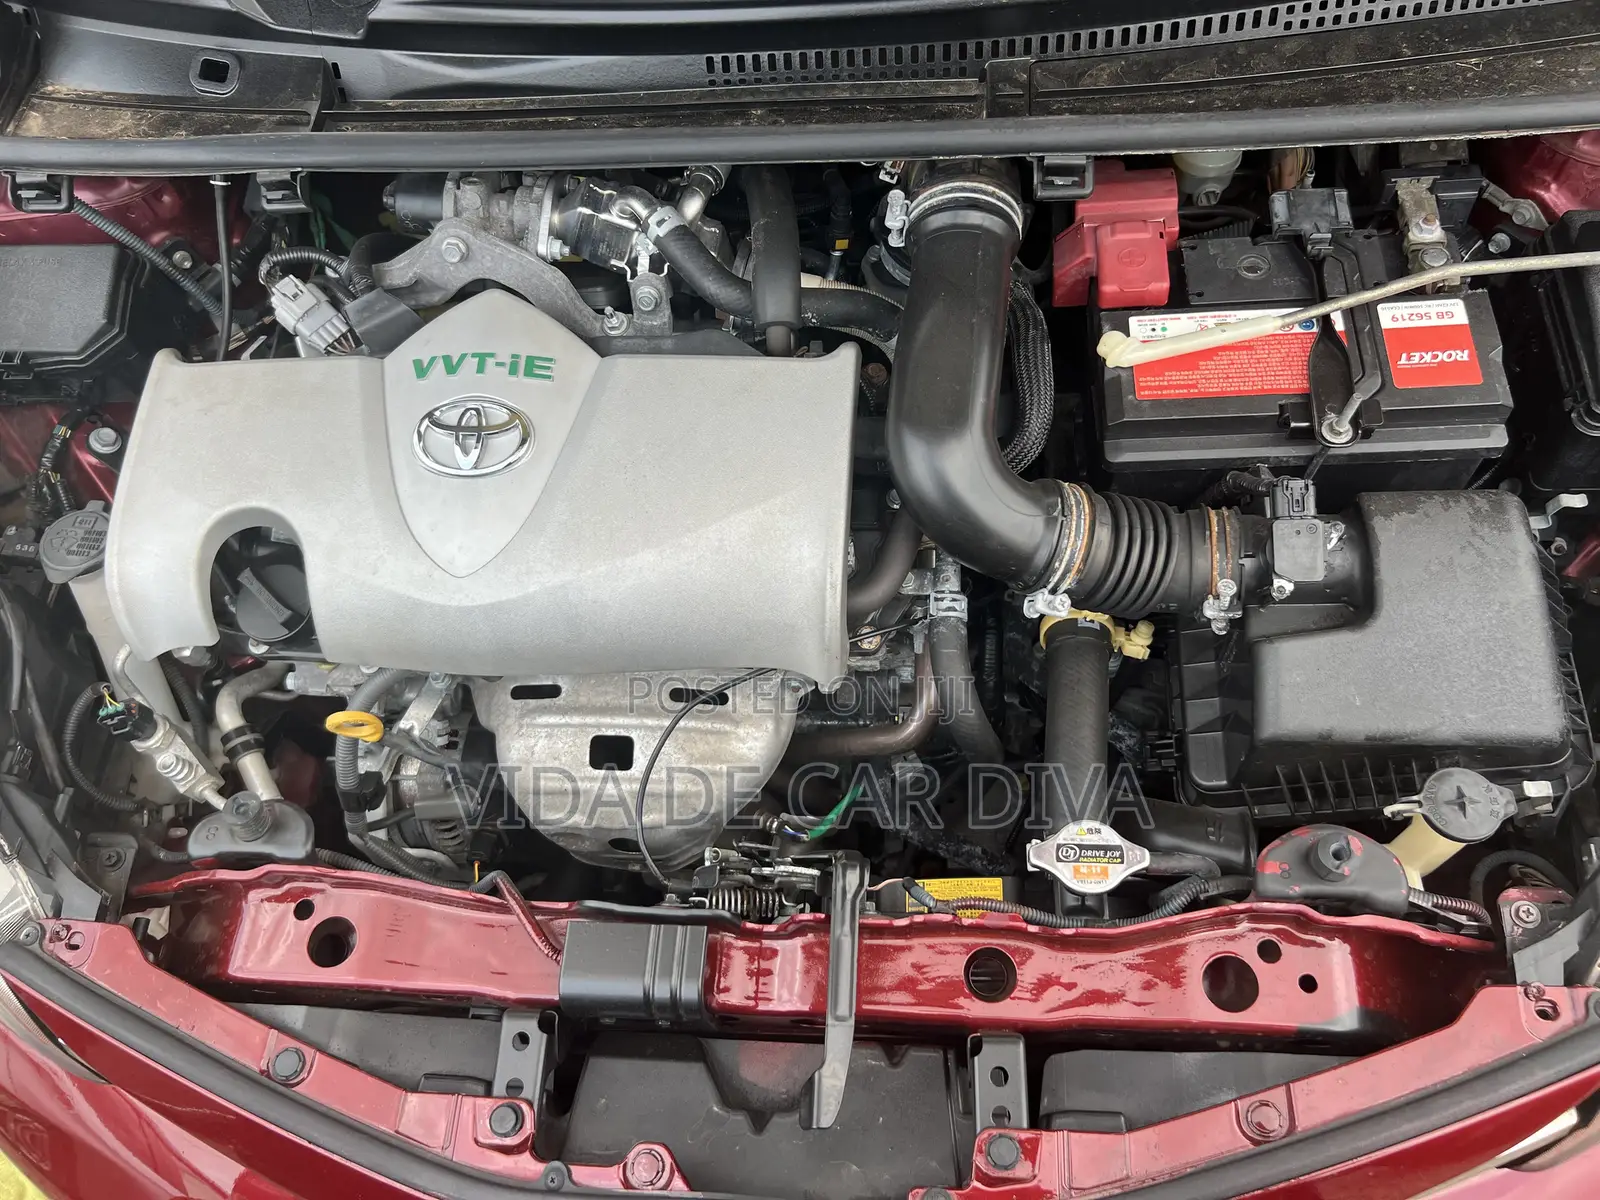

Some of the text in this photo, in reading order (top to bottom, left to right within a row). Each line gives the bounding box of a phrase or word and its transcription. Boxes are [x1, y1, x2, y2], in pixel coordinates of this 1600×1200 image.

[1391, 310, 1455, 322] GB 56219
[1396, 349, 1470, 365] ROCKET
[412, 352, 556, 382] VVT-iE
[1080, 849, 1105, 857] DRIVE
[1105, 850, 1121, 858] JOY
